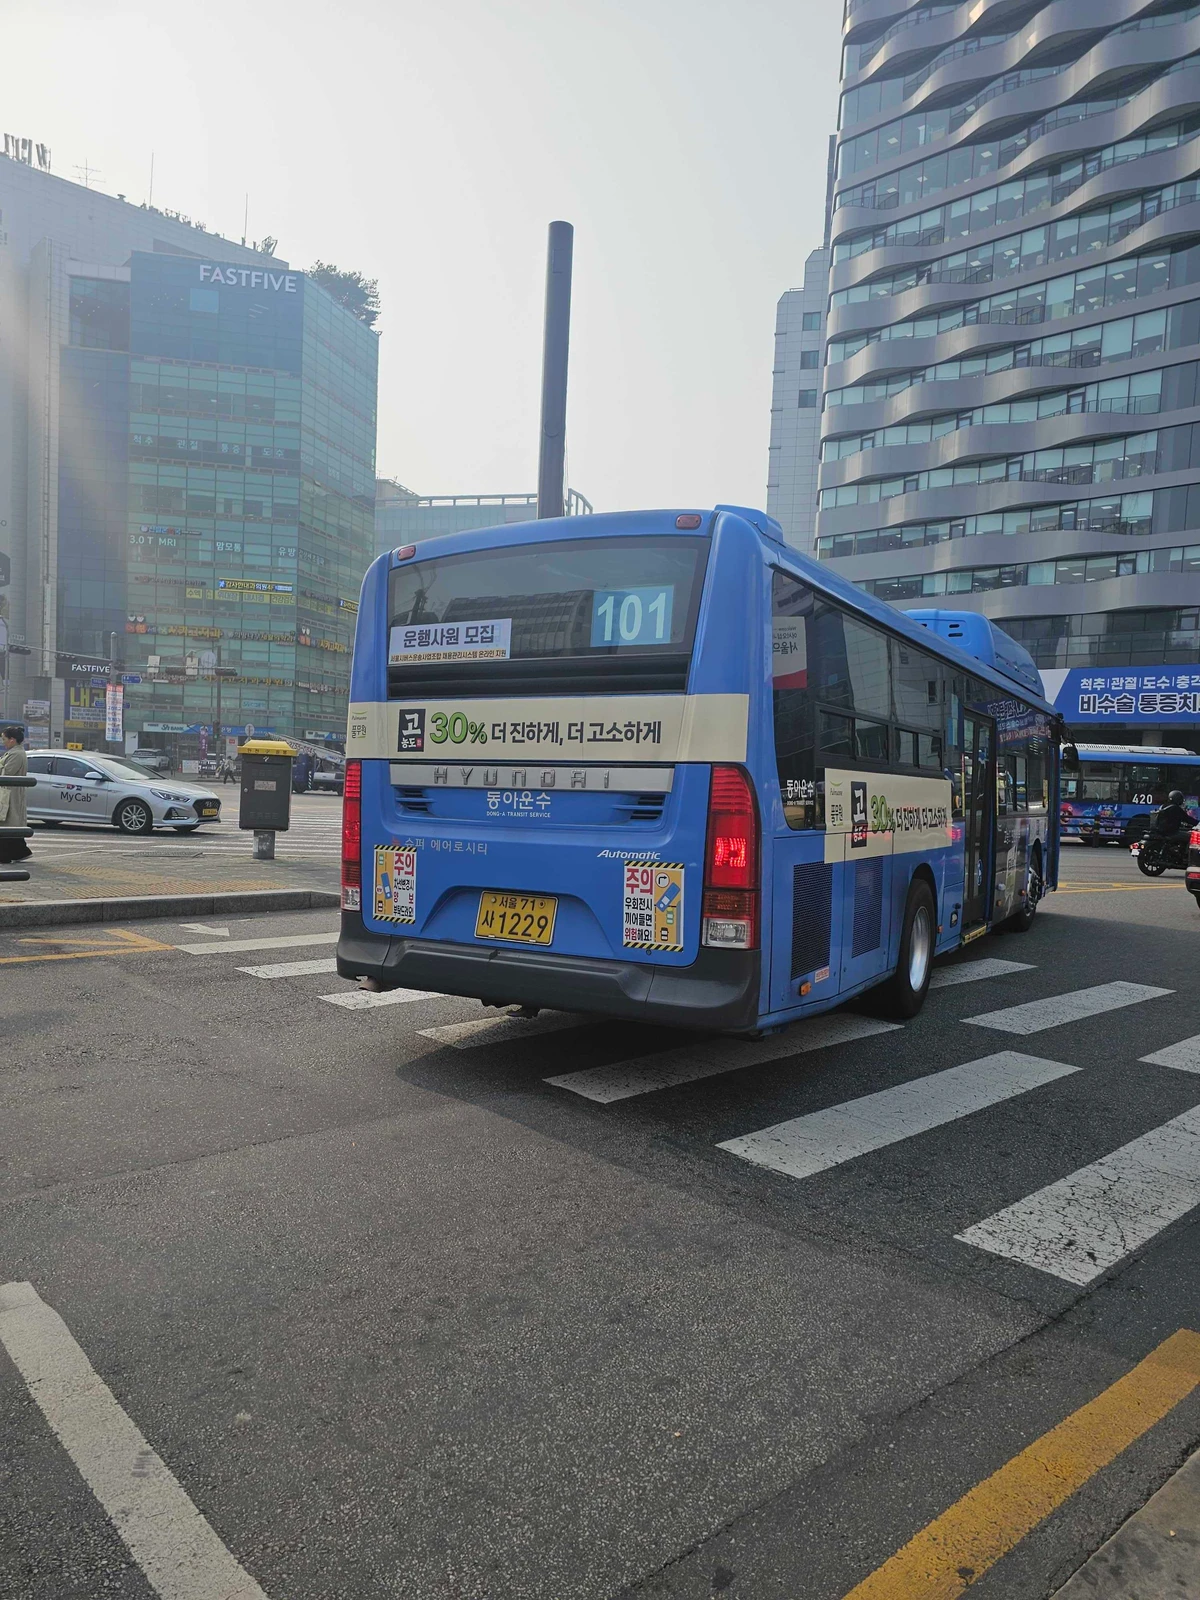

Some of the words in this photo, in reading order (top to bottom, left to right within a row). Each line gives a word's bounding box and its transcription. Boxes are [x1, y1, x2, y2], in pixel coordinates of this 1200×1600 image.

[199, 264, 297, 293] FASTFIVE
[133, 434, 153, 446] 척추
[176, 439, 199, 450] 관절
[262, 448, 284, 458] 도수
[129, 535, 145, 545] 3.0
[147, 536, 154, 545] T
[158, 537, 177, 547] MRI
[278, 546, 297, 558] 유방
[597, 592, 666, 641] 101
[403, 627, 459, 648] 운행사원
[464, 625, 495, 644] 모집
[478, 650, 494, 659] 온라인
[496, 649, 507, 658] 지원
[71, 663, 111, 674] FASTFIVE
[1080, 677, 1105, 691] 척추
[1111, 676, 1137, 690] 관절
[1143, 675, 1170, 690] 도수
[1079, 693, 1135, 714] 비수술
[1138, 692, 1200, 714] 통증치
[351, 724, 367, 739] 풀무원
[402, 712, 421, 736] 고
[429, 711, 488, 744] 30%
[491, 721, 506, 744] 더
[510, 721, 564, 746] 진하게,
[567, 721, 584, 744] 더
[587, 720, 662, 744] 고소하게
[401, 737, 417, 749] 농도
[434, 766, 610, 789] HYUNDAI
[786, 779, 814, 799] 동아운수
[486, 791, 551, 810] 동아운수
[1132, 793, 1153, 805] 420
[870, 794, 896, 834] 30%
[430, 839, 488, 855] 에어로시티
[597, 849, 661, 860] Automatic
[393, 852, 415, 877] 주의
[626, 868, 654, 895] 주의
[499, 896, 517, 910] 서울
[520, 898, 536, 911] 71
[624, 897, 653, 911] 우회전시
[481, 910, 495, 928] 사
[498, 911, 549, 938] 1229
[624, 912, 653, 927] 끼어들면
[624, 927, 652, 942] 위험해요!
